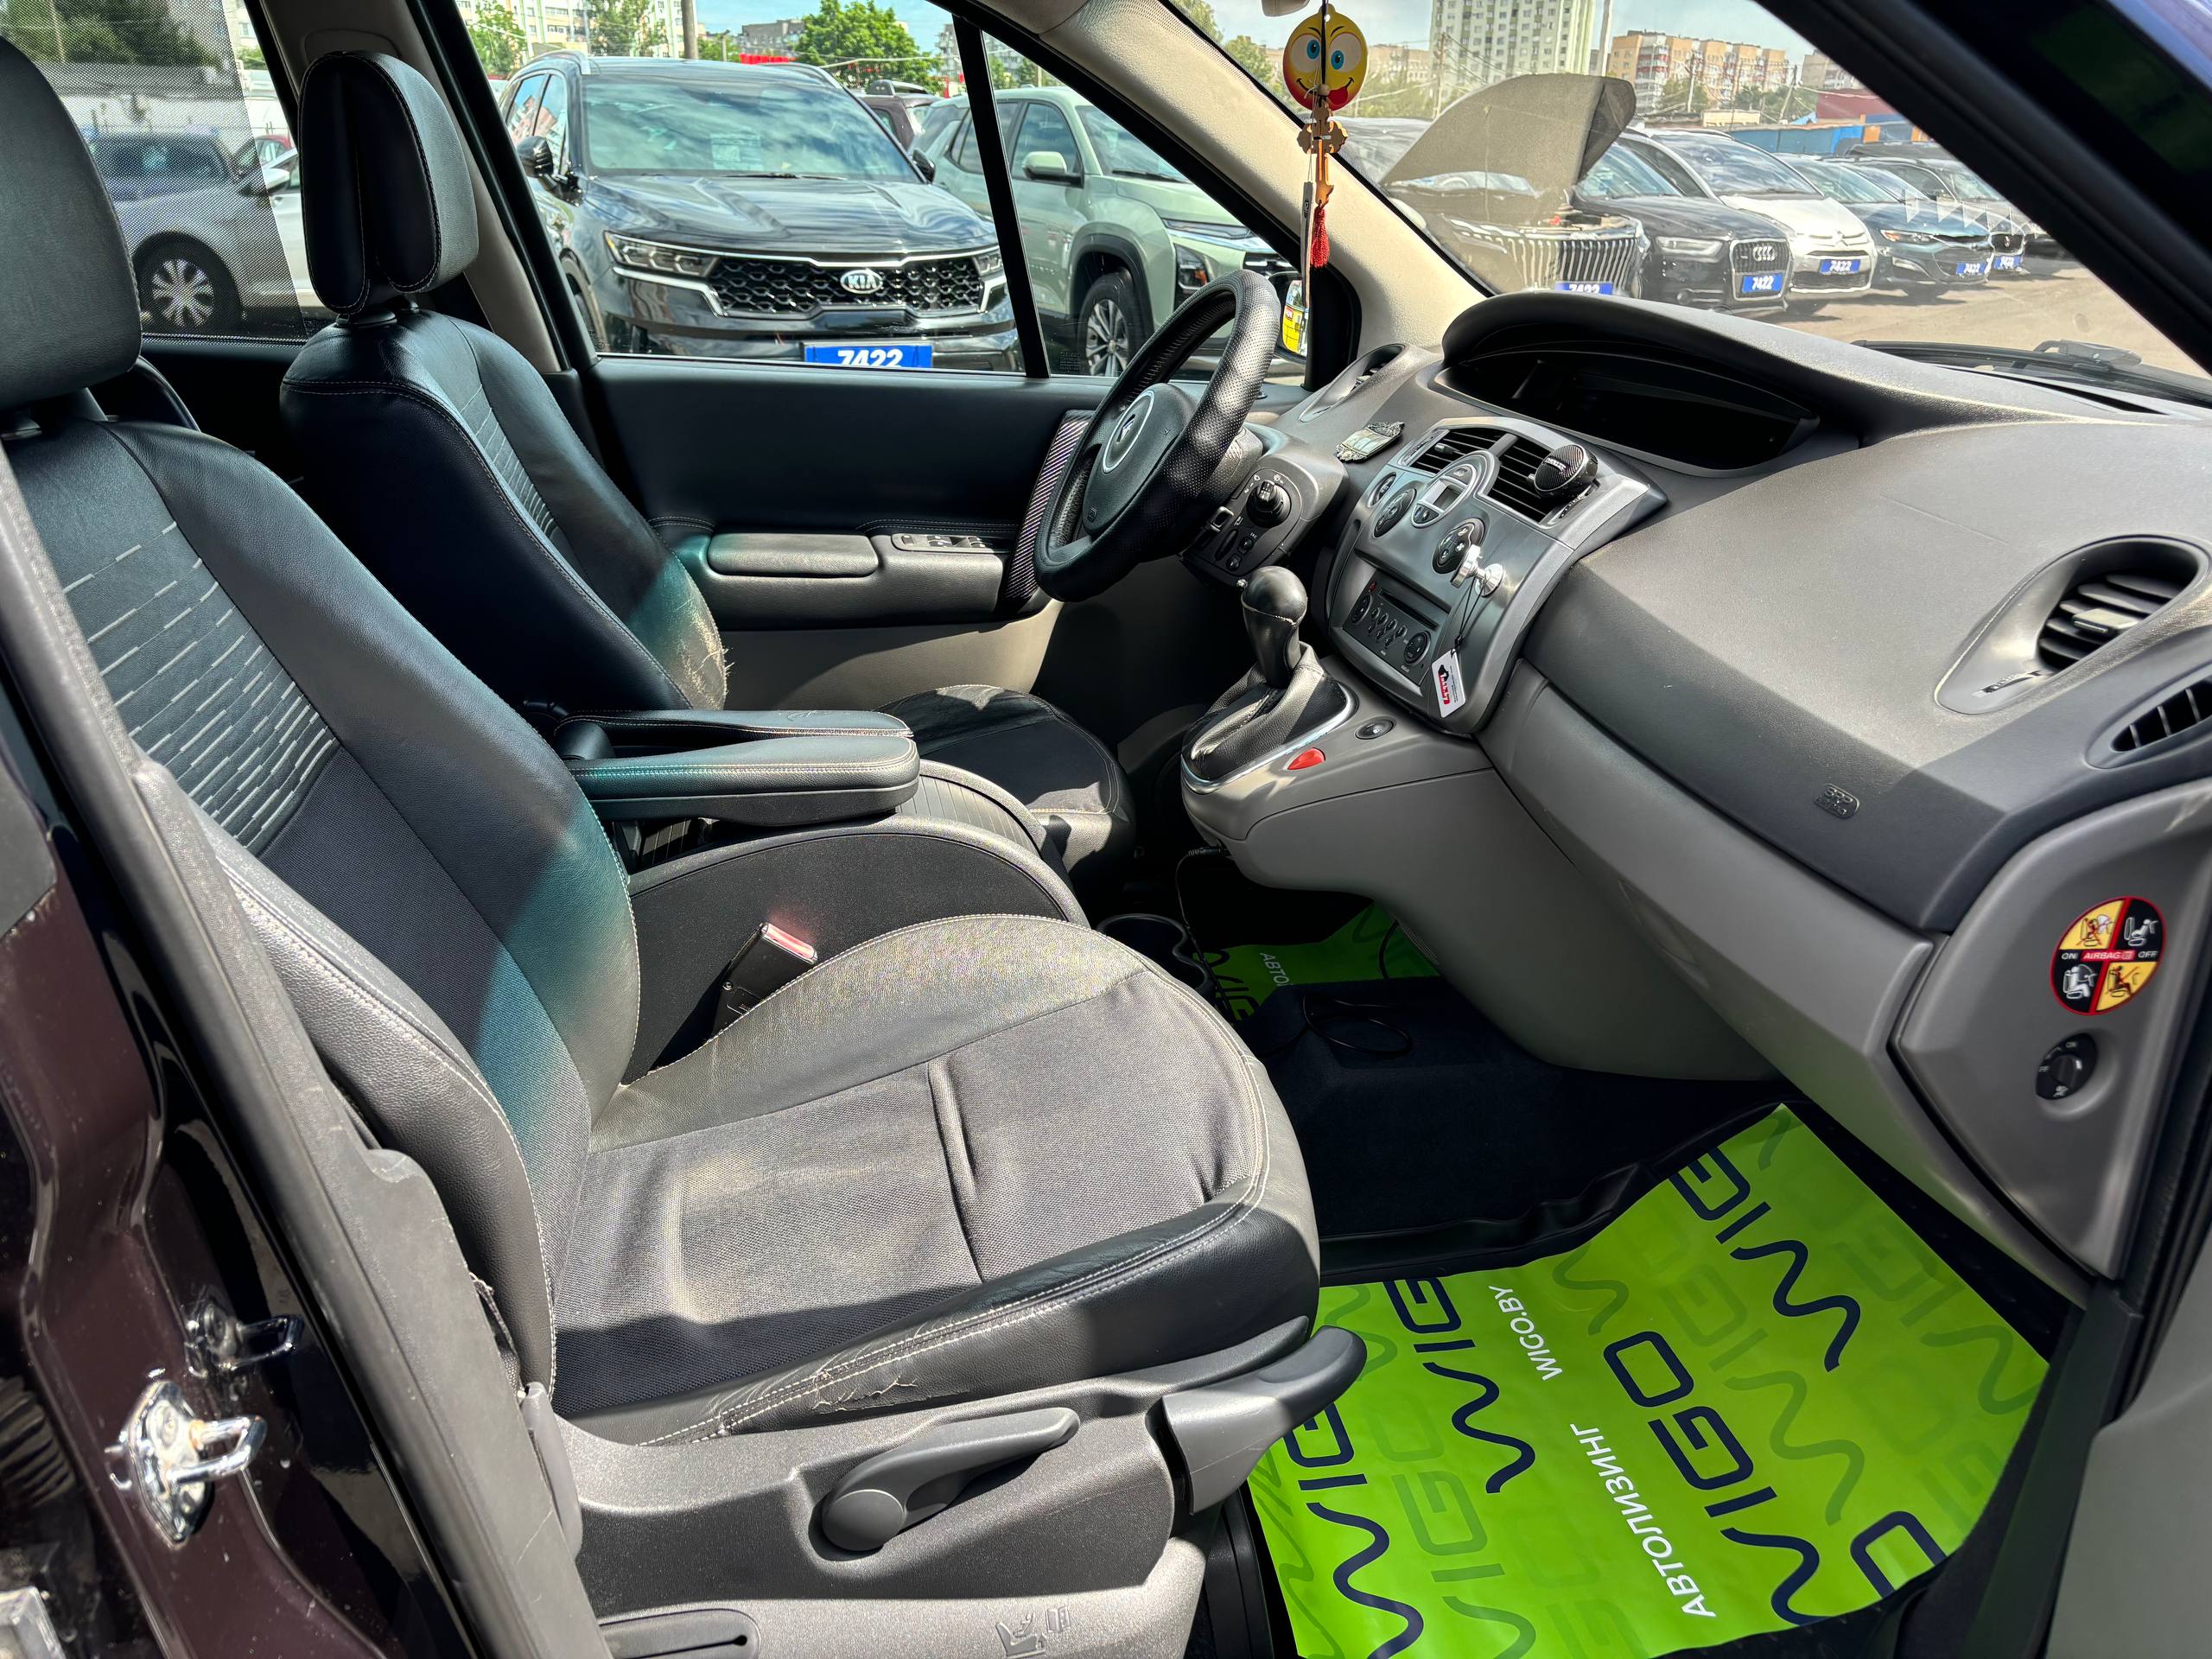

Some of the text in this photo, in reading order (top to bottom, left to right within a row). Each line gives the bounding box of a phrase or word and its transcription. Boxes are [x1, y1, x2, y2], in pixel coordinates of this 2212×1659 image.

[1830, 259, 1853, 271] 7422
[1752, 276, 1774, 290] 7422
[837, 348, 904, 367] 7422
[2083, 951, 2120, 960] AIRBAG
[2138, 950, 2158, 959] OFF
[1260, 952, 1294, 987] АВТО
[1488, 1285, 1562, 1382] WIGO.BY
[1603, 1331, 1834, 1626] WIGO
[1570, 1422, 1717, 1618] АВТОЛИЗИНГ
